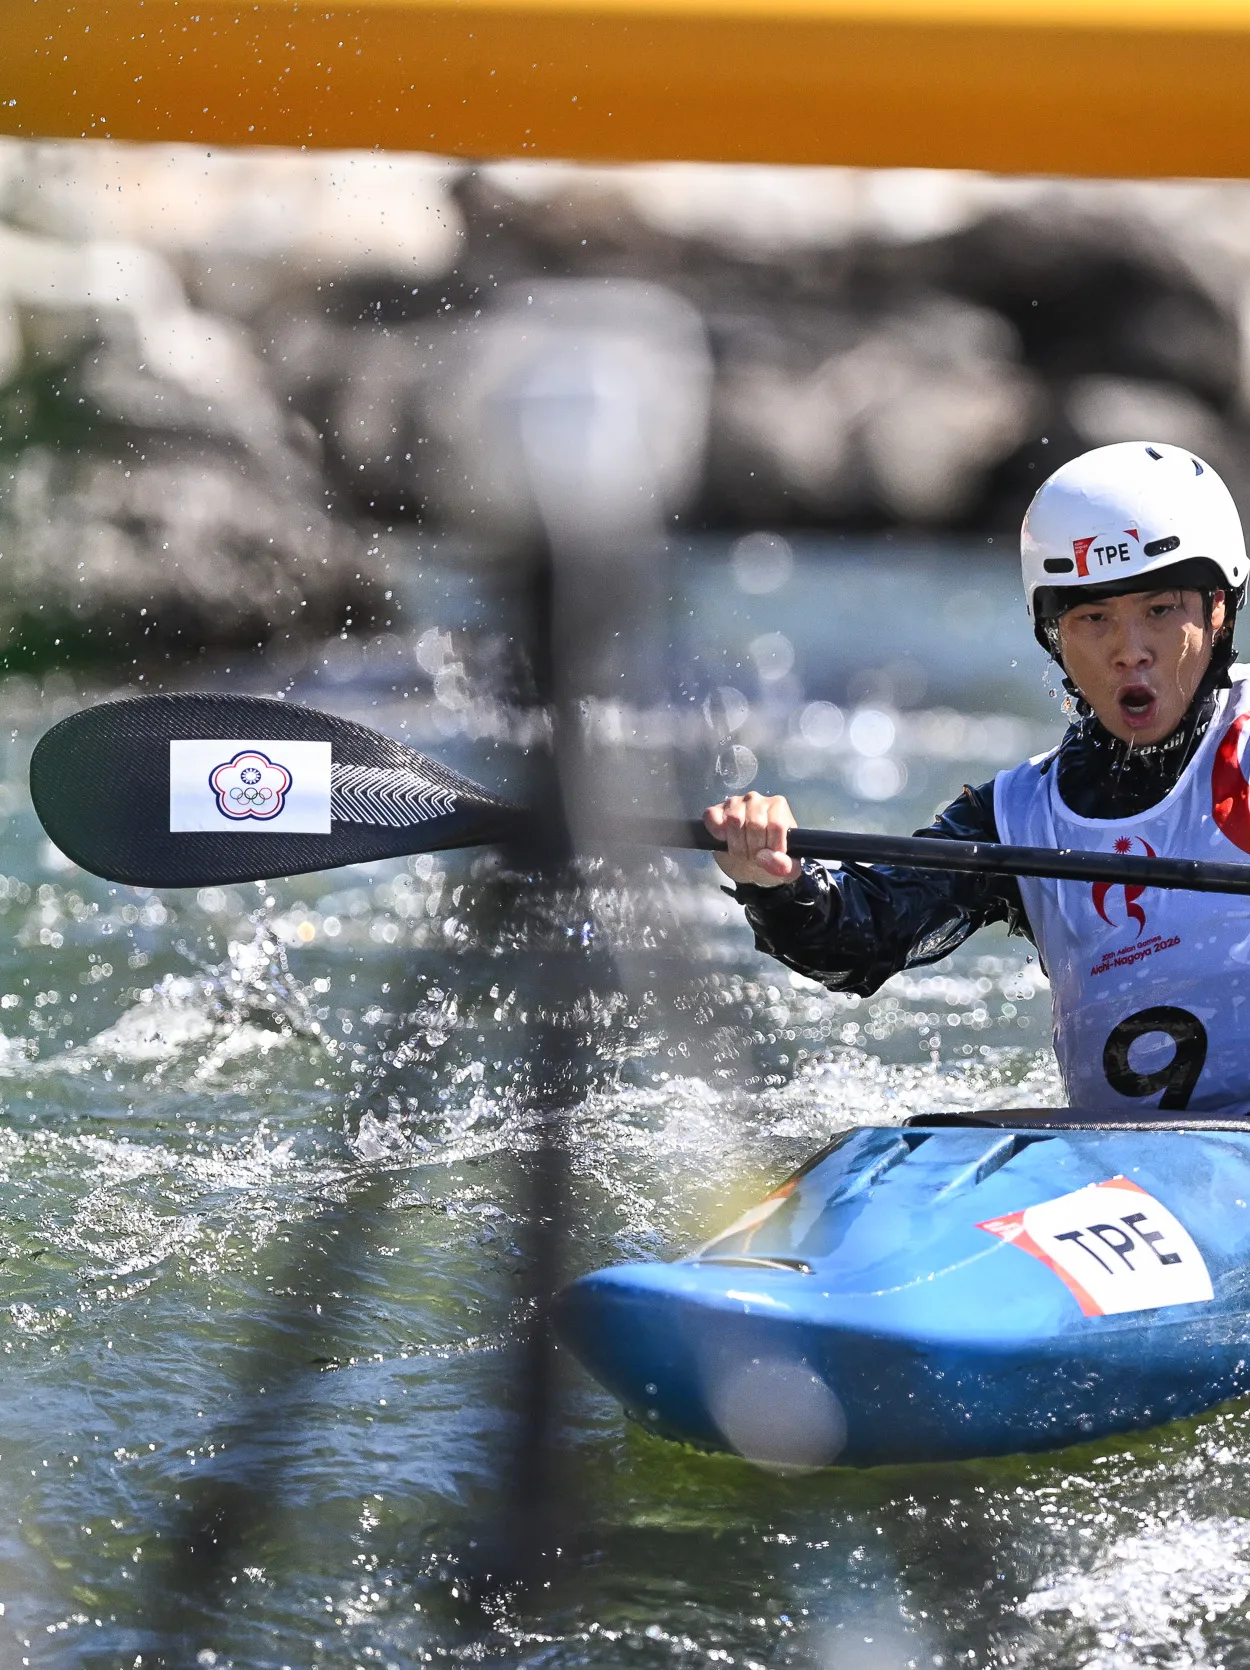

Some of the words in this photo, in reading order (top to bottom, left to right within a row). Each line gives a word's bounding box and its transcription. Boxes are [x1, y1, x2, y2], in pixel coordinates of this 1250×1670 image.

[1093, 542, 1130, 566] TPE
[1090, 948, 1152, 976] Aichi-Nagoya
[1153, 935, 1181, 953] 2026
[1117, 945, 1136, 956] Asian
[1137, 935, 1162, 949] Games
[1103, 1005, 1208, 1110] 9
[1052, 1212, 1183, 1275] TPE
